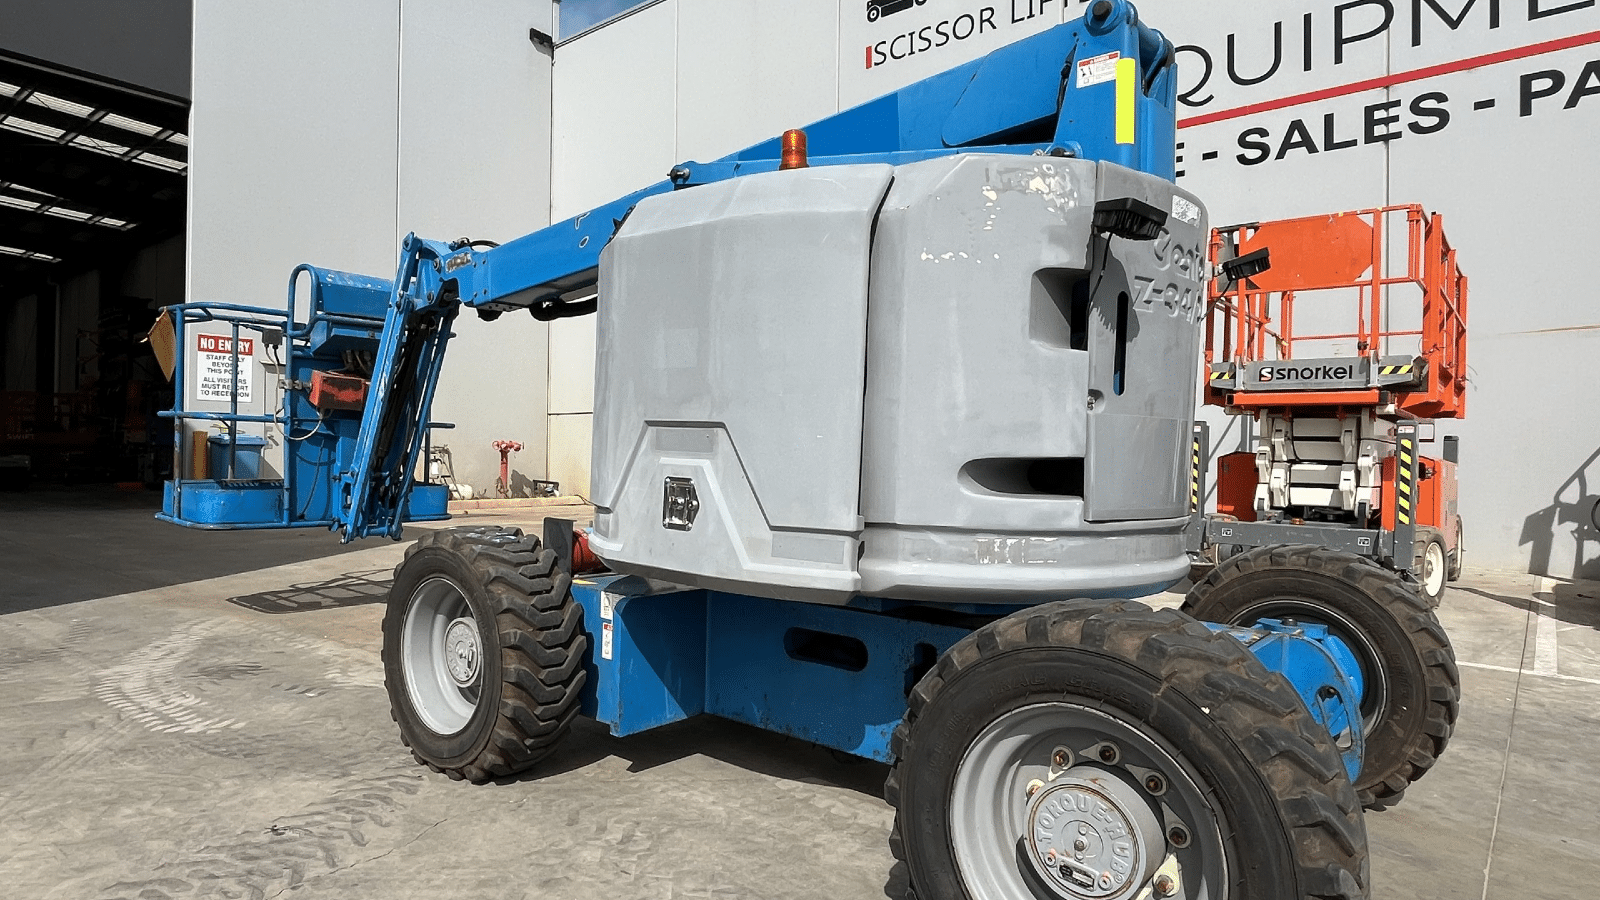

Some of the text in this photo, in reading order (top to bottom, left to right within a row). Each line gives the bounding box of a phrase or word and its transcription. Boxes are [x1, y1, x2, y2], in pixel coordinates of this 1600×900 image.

[873, 6, 997, 67] SCISSOR
[1236, 91, 1451, 166] SALES
[200, 337, 251, 353] NO ENRY
[1276, 364, 1353, 380] snorkel
[217, 377, 247, 385] VISITRS
[222, 384, 249, 392] REORT
